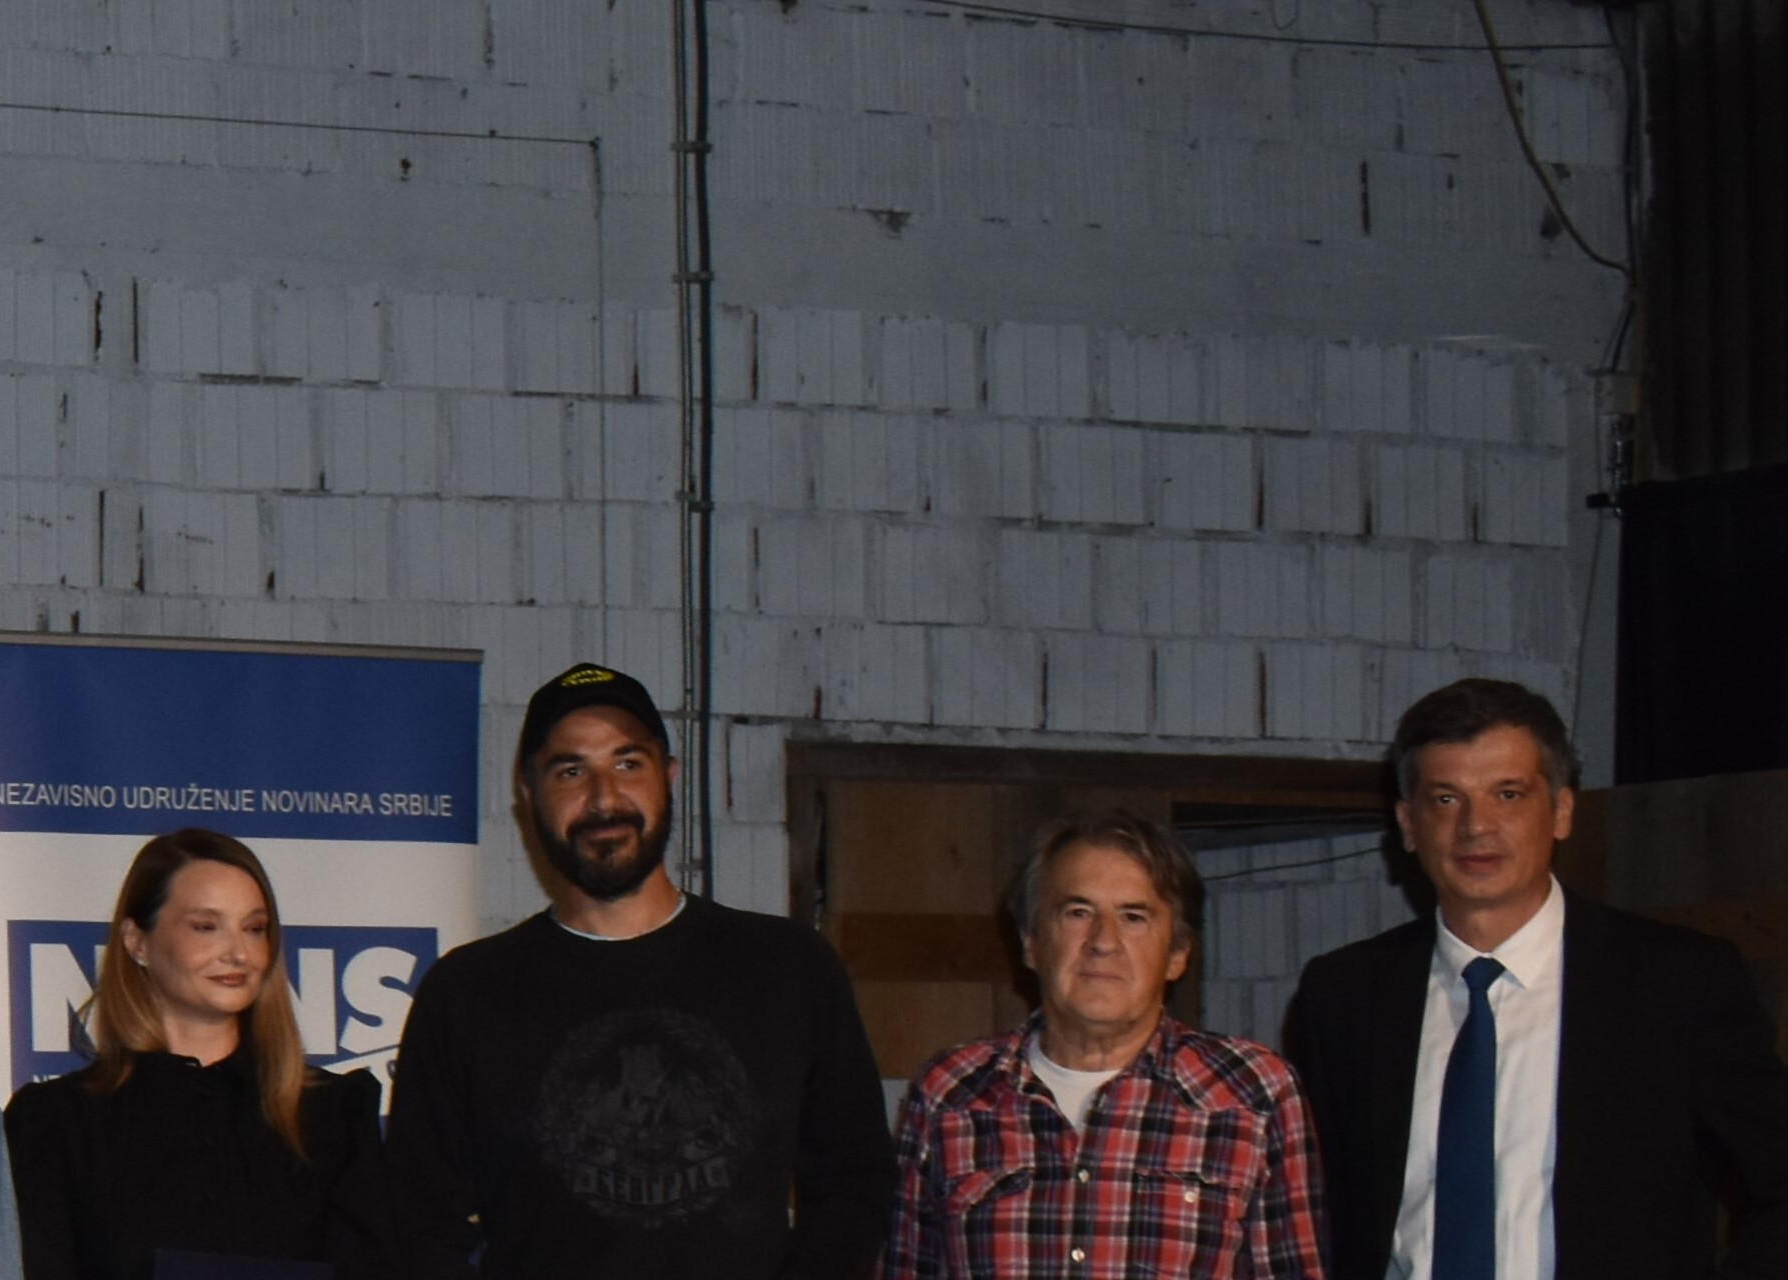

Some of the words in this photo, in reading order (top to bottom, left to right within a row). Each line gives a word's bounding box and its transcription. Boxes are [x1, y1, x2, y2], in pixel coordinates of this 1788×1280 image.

[123, 783, 255, 813] UDRUŽENJE
[262, 790, 375, 816] NOVINARA
[378, 792, 453, 818] SRBIJE
[29, 942, 418, 1057] NNS
